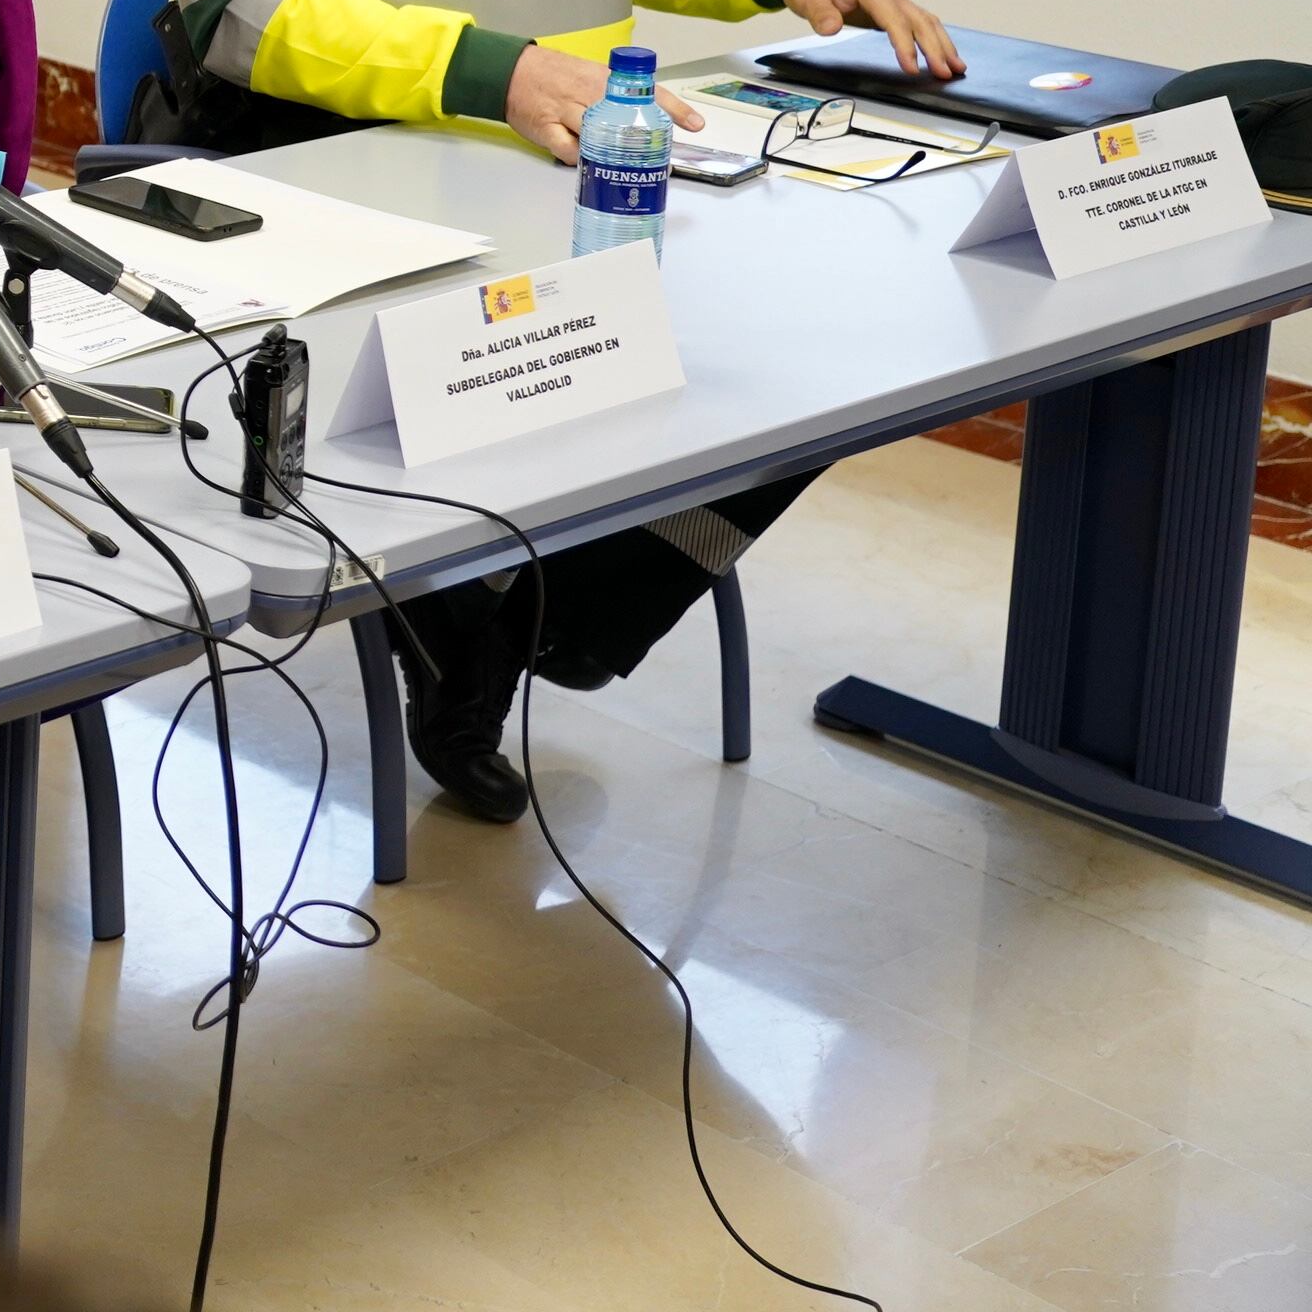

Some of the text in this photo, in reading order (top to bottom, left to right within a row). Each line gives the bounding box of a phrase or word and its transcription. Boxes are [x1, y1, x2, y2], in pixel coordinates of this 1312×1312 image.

[594, 167, 667, 183] FUENSANTA
[1058, 151, 1217, 199] D. FCO. ENRIQUE GONZÁLEZ ITURRALDE
[1085, 178, 1208, 218] TTE. CORONEL DE LA ATGC EN
[1119, 204, 1190, 230] CASTILLA Y LEÓN
[462, 316, 596, 362] Dña. ALICIA VILLAR PÉREZ
[447, 338, 619, 395] SUBDELEGADA DEL GOBIERNO EN
[507, 375, 571, 402] VALLADOLID
